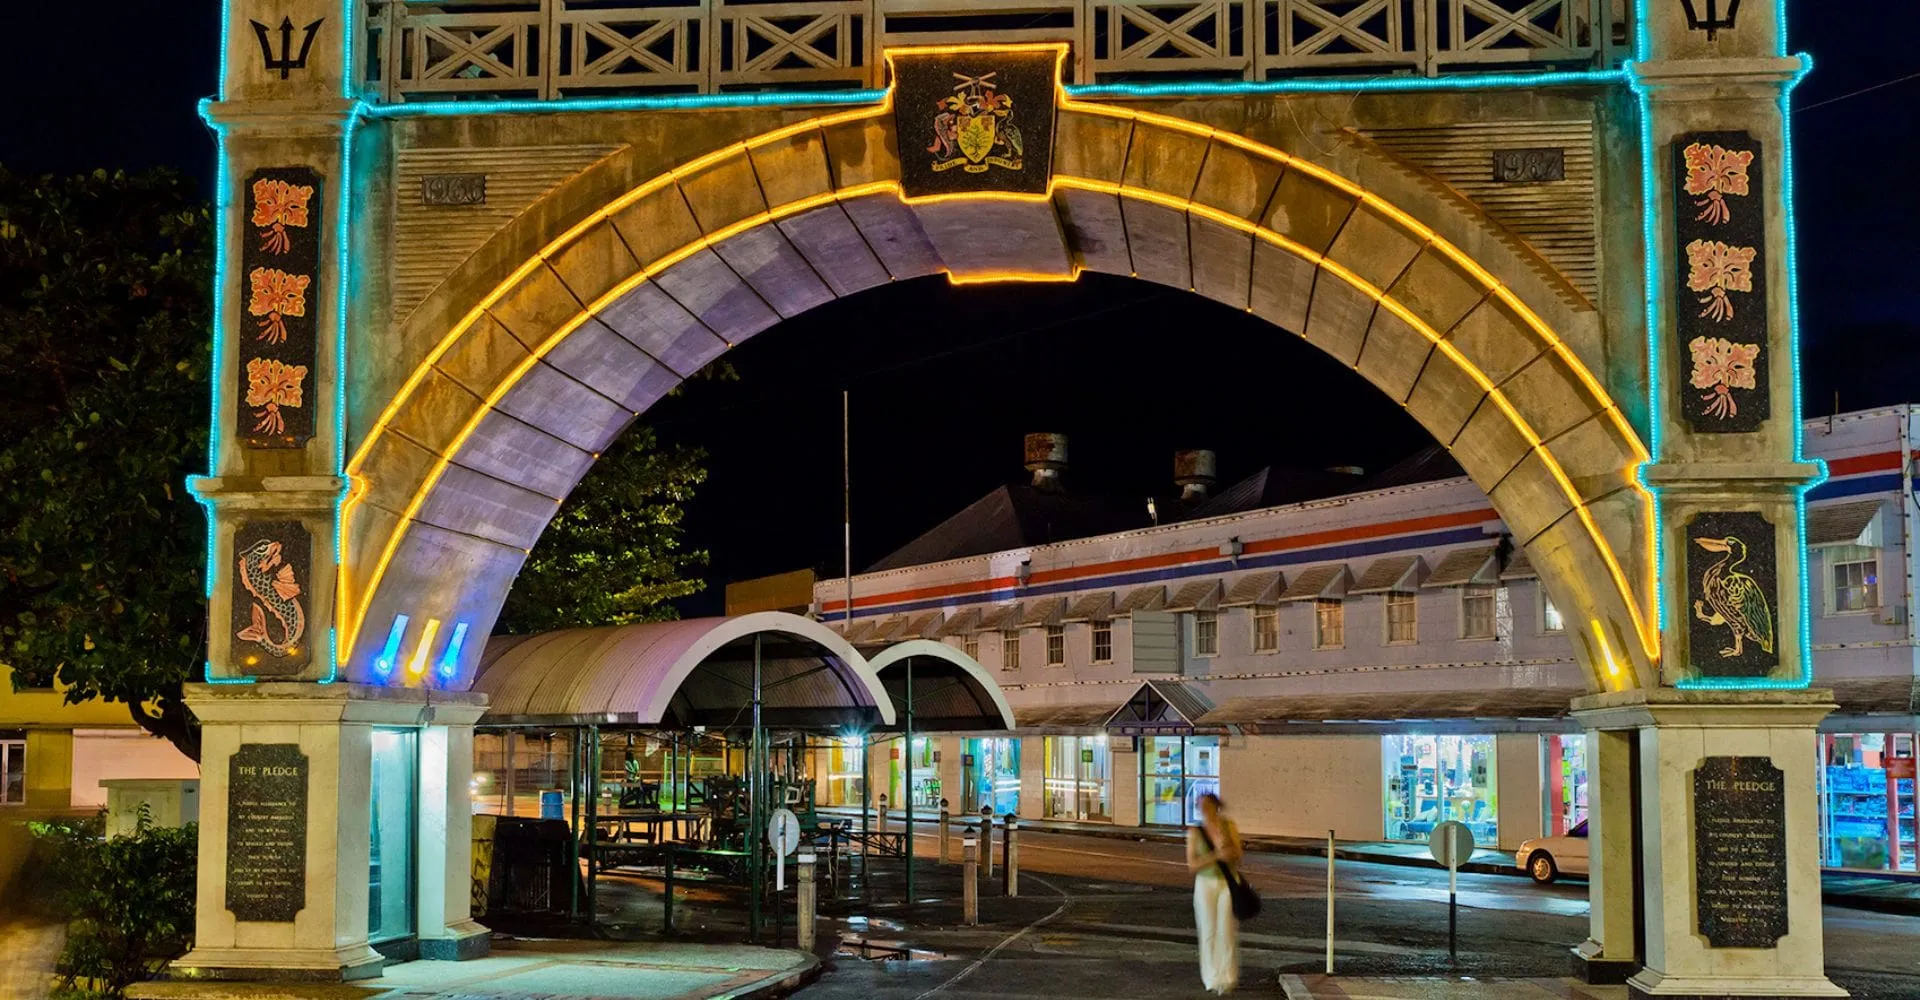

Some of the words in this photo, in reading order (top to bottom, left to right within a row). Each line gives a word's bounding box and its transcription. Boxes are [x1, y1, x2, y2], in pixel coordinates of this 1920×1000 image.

[239, 766, 257, 776] THE
[263, 766, 298, 777] PLEDGE
[1706, 780, 1727, 790] THE
[1734, 780, 1776, 792] PLEDGE
